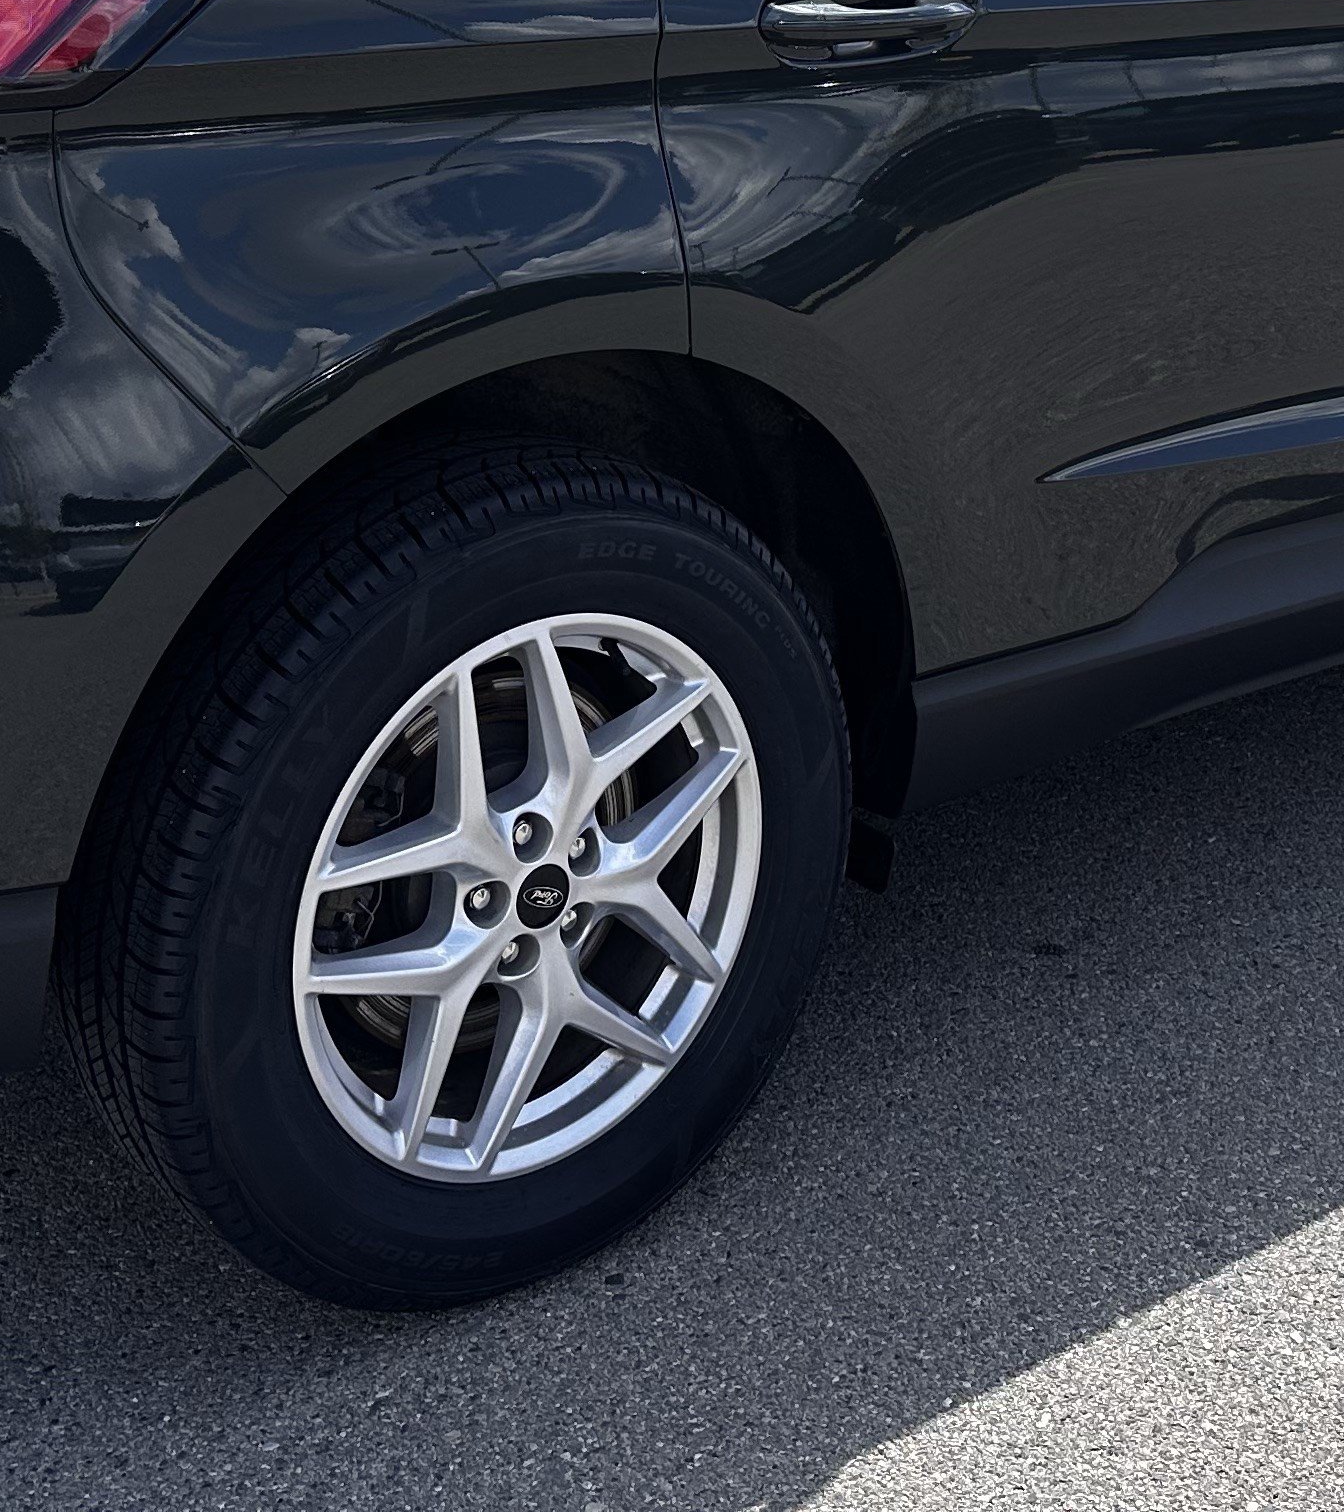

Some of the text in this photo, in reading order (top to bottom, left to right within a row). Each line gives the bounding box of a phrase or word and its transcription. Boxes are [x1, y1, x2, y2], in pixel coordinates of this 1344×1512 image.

[577, 540, 657, 561] EDGE
[674, 552, 771, 628] TOURING
[225, 702, 334, 952] KELLY
[529, 890, 559, 906] Ford
